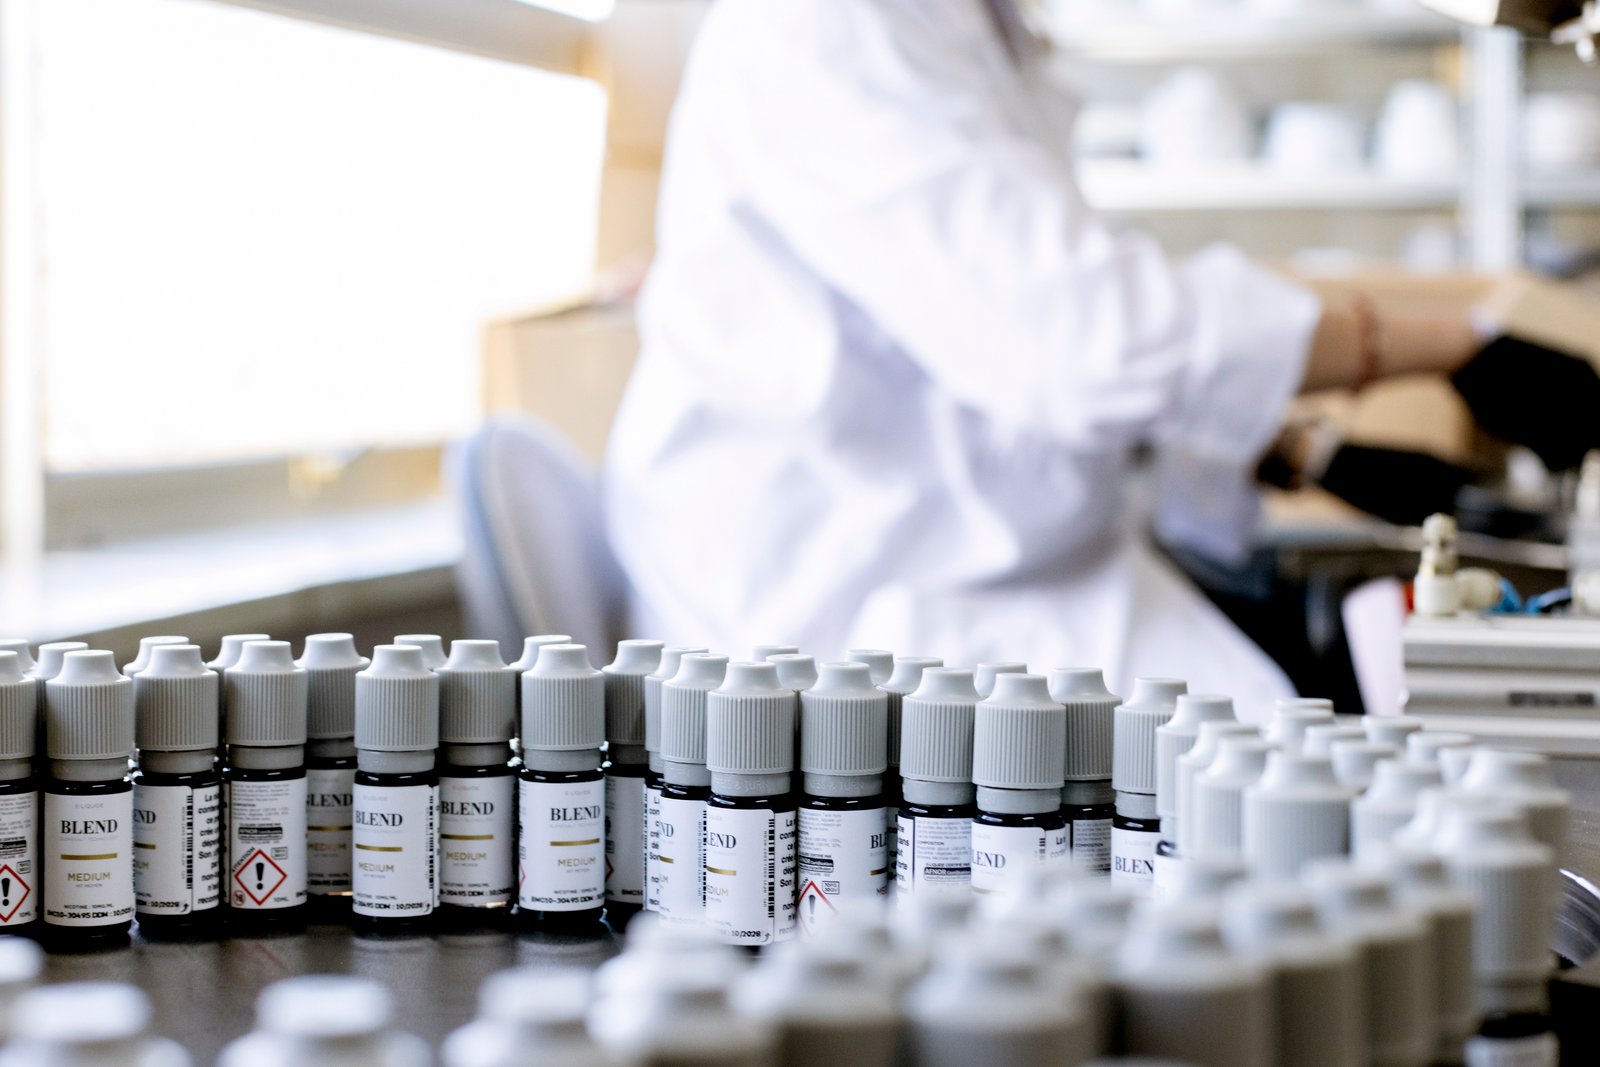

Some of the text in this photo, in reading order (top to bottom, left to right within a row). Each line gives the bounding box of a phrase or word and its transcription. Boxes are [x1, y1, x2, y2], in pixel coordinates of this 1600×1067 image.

[134, 808, 156, 824] END
[441, 800, 495, 816] BLEND
[550, 804, 601, 822] BLEND
[60, 819, 118, 835] BLEND
[355, 810, 403, 828] BLEND
[707, 831, 737, 849] END
[446, 852, 487, 862] MEDIUM
[557, 857, 597, 868] MEDIUM
[973, 850, 1006, 869] END
[358, 862, 395, 873] MEDIUM
[1115, 856, 1155, 875] BLEN
[67, 872, 111, 882] MEDIUM
[707, 884, 729, 897] EDIUM
